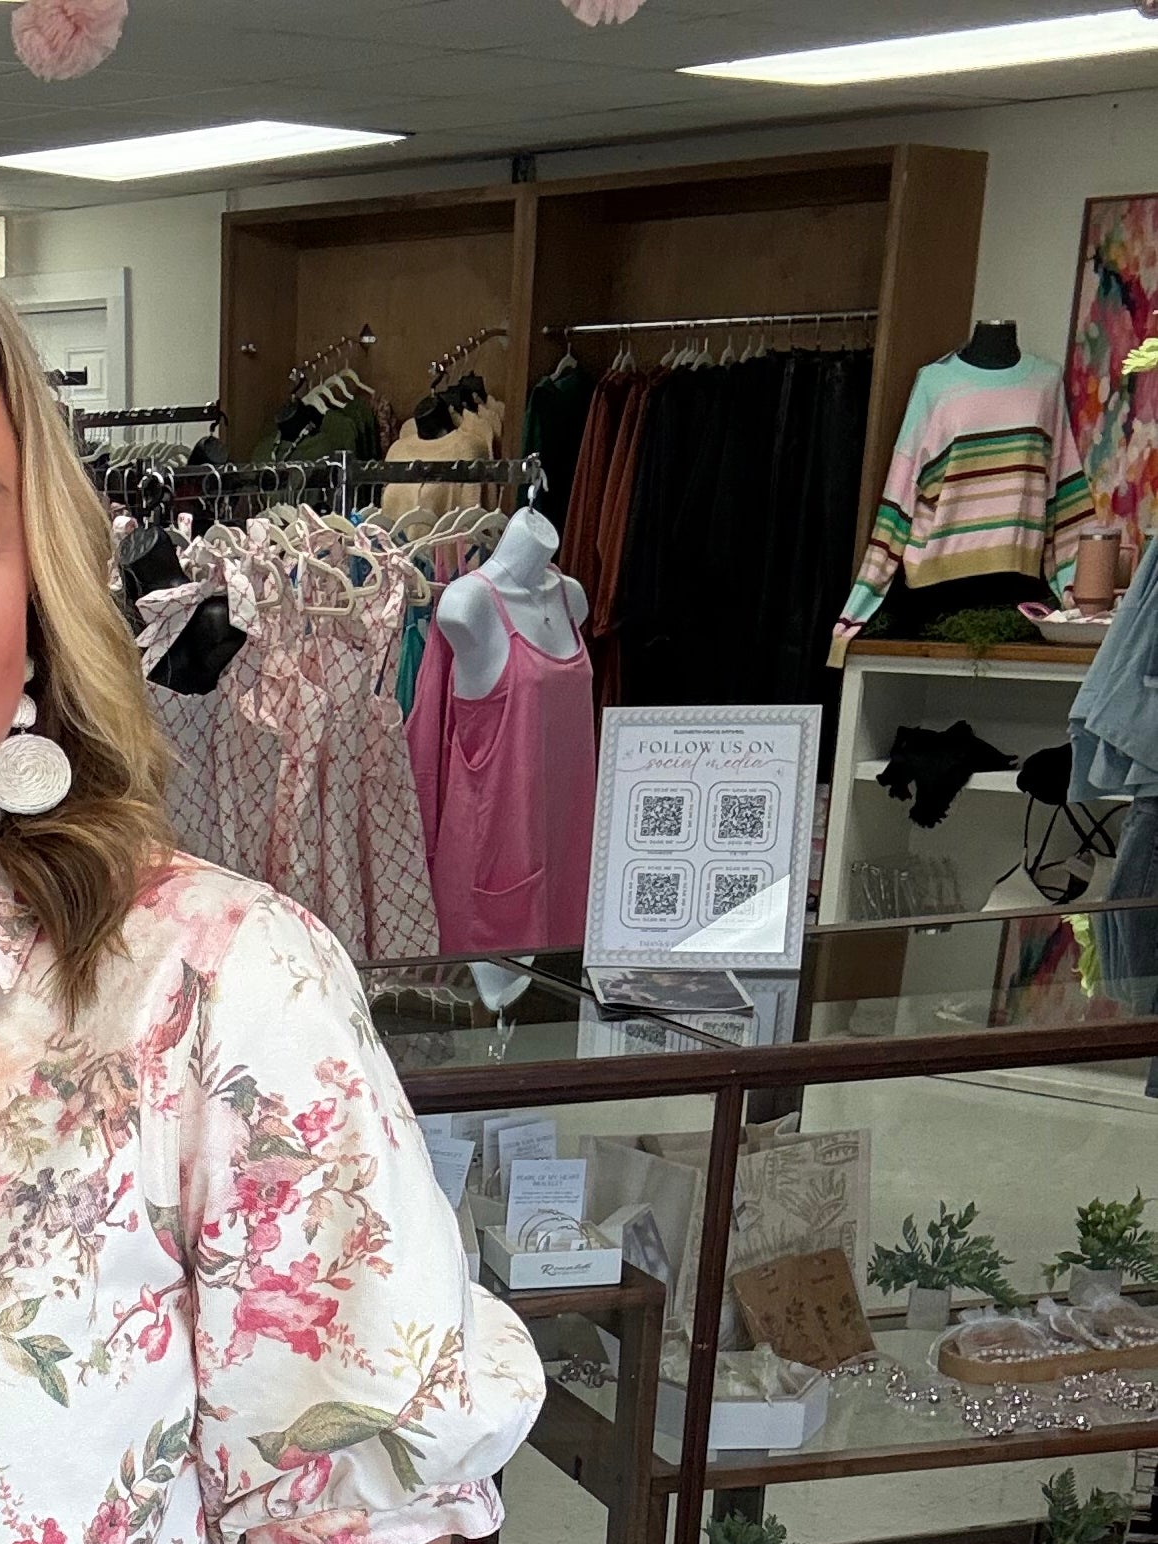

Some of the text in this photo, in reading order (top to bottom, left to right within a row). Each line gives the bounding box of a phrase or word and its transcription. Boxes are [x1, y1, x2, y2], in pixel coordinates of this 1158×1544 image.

[639, 740, 775, 754] FOLLOW US ON
[705, 751, 767, 775] media
